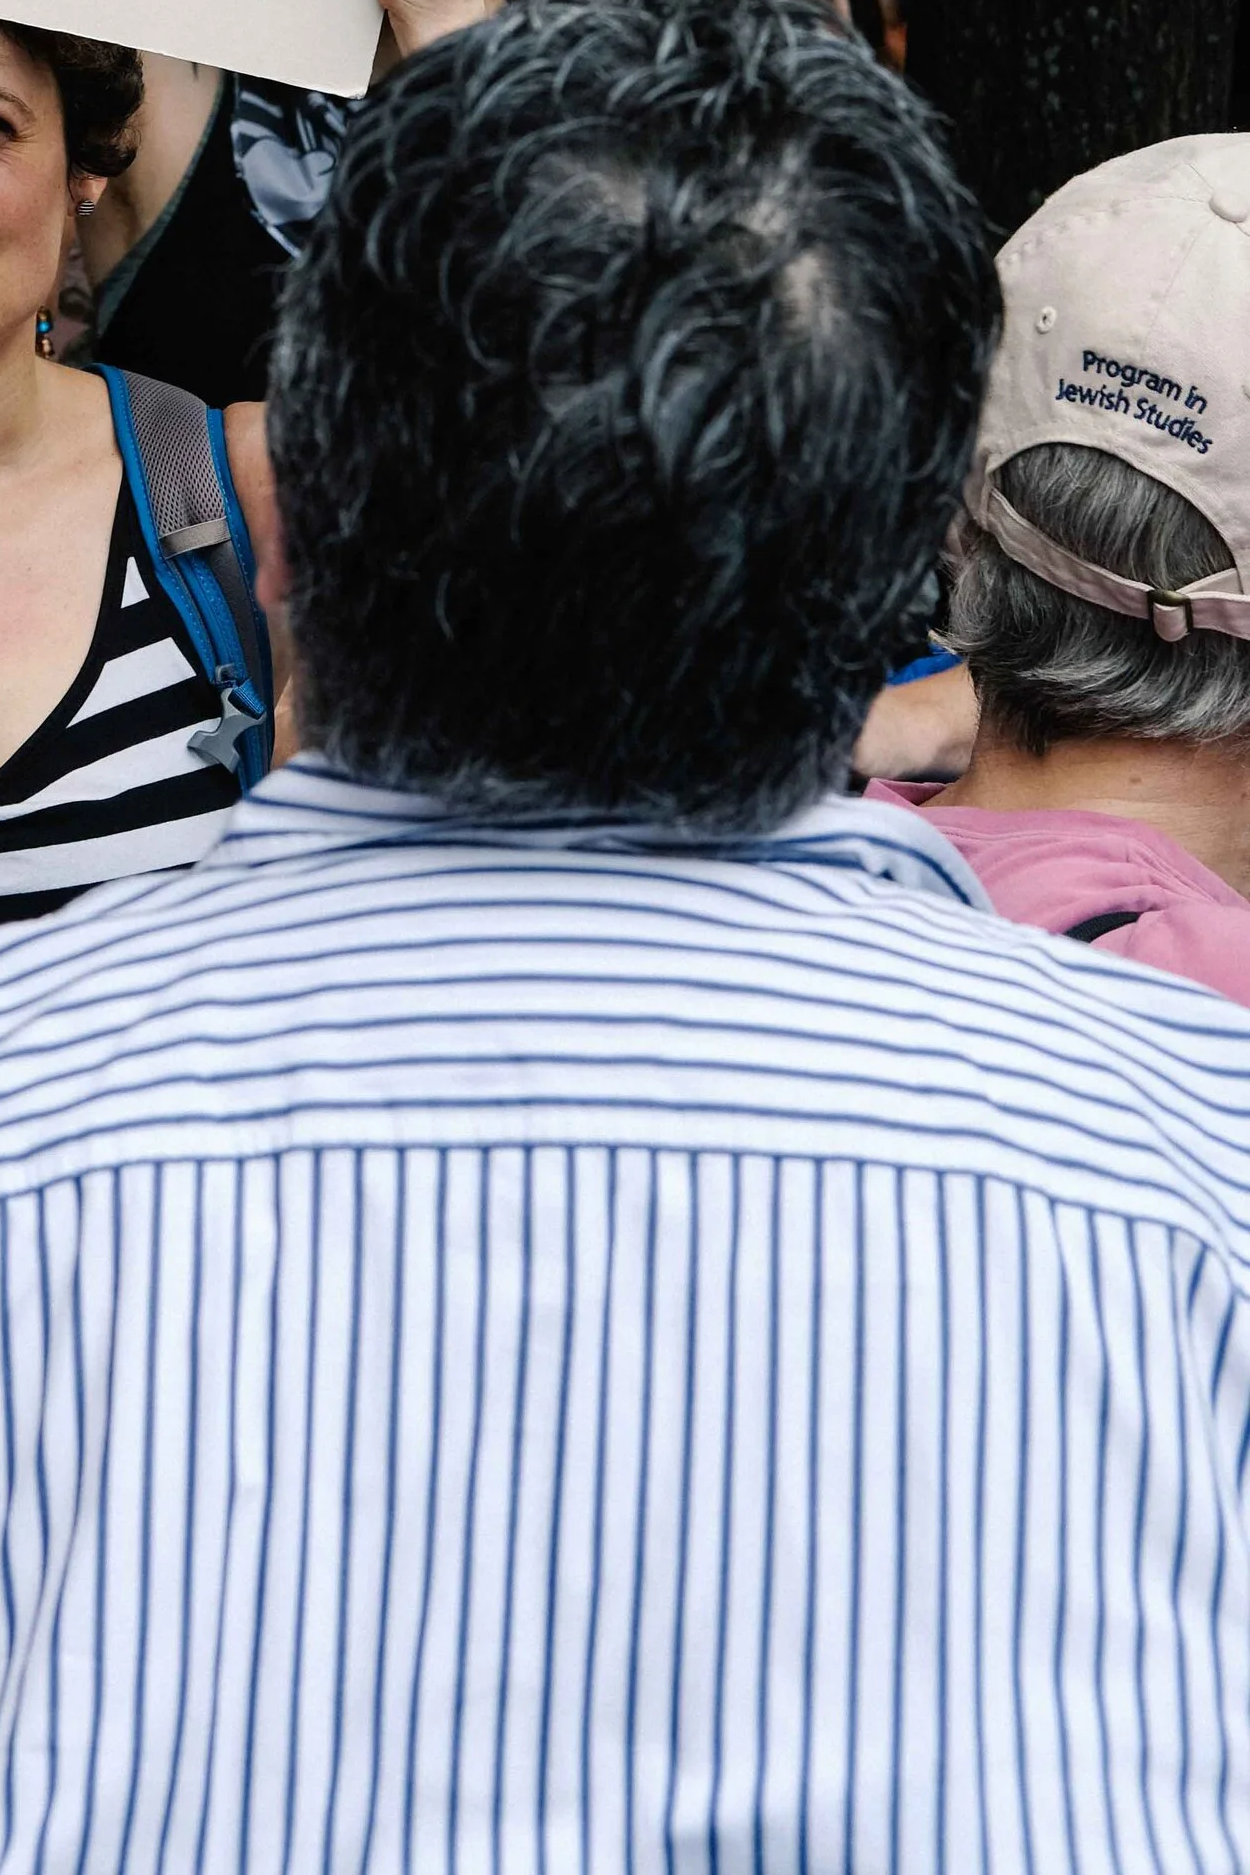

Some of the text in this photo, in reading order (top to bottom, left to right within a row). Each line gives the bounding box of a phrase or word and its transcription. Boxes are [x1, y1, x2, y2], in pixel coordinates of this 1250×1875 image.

[1054, 378, 1214, 455] Jewish Studies
[1082, 349, 1208, 415] Program in
